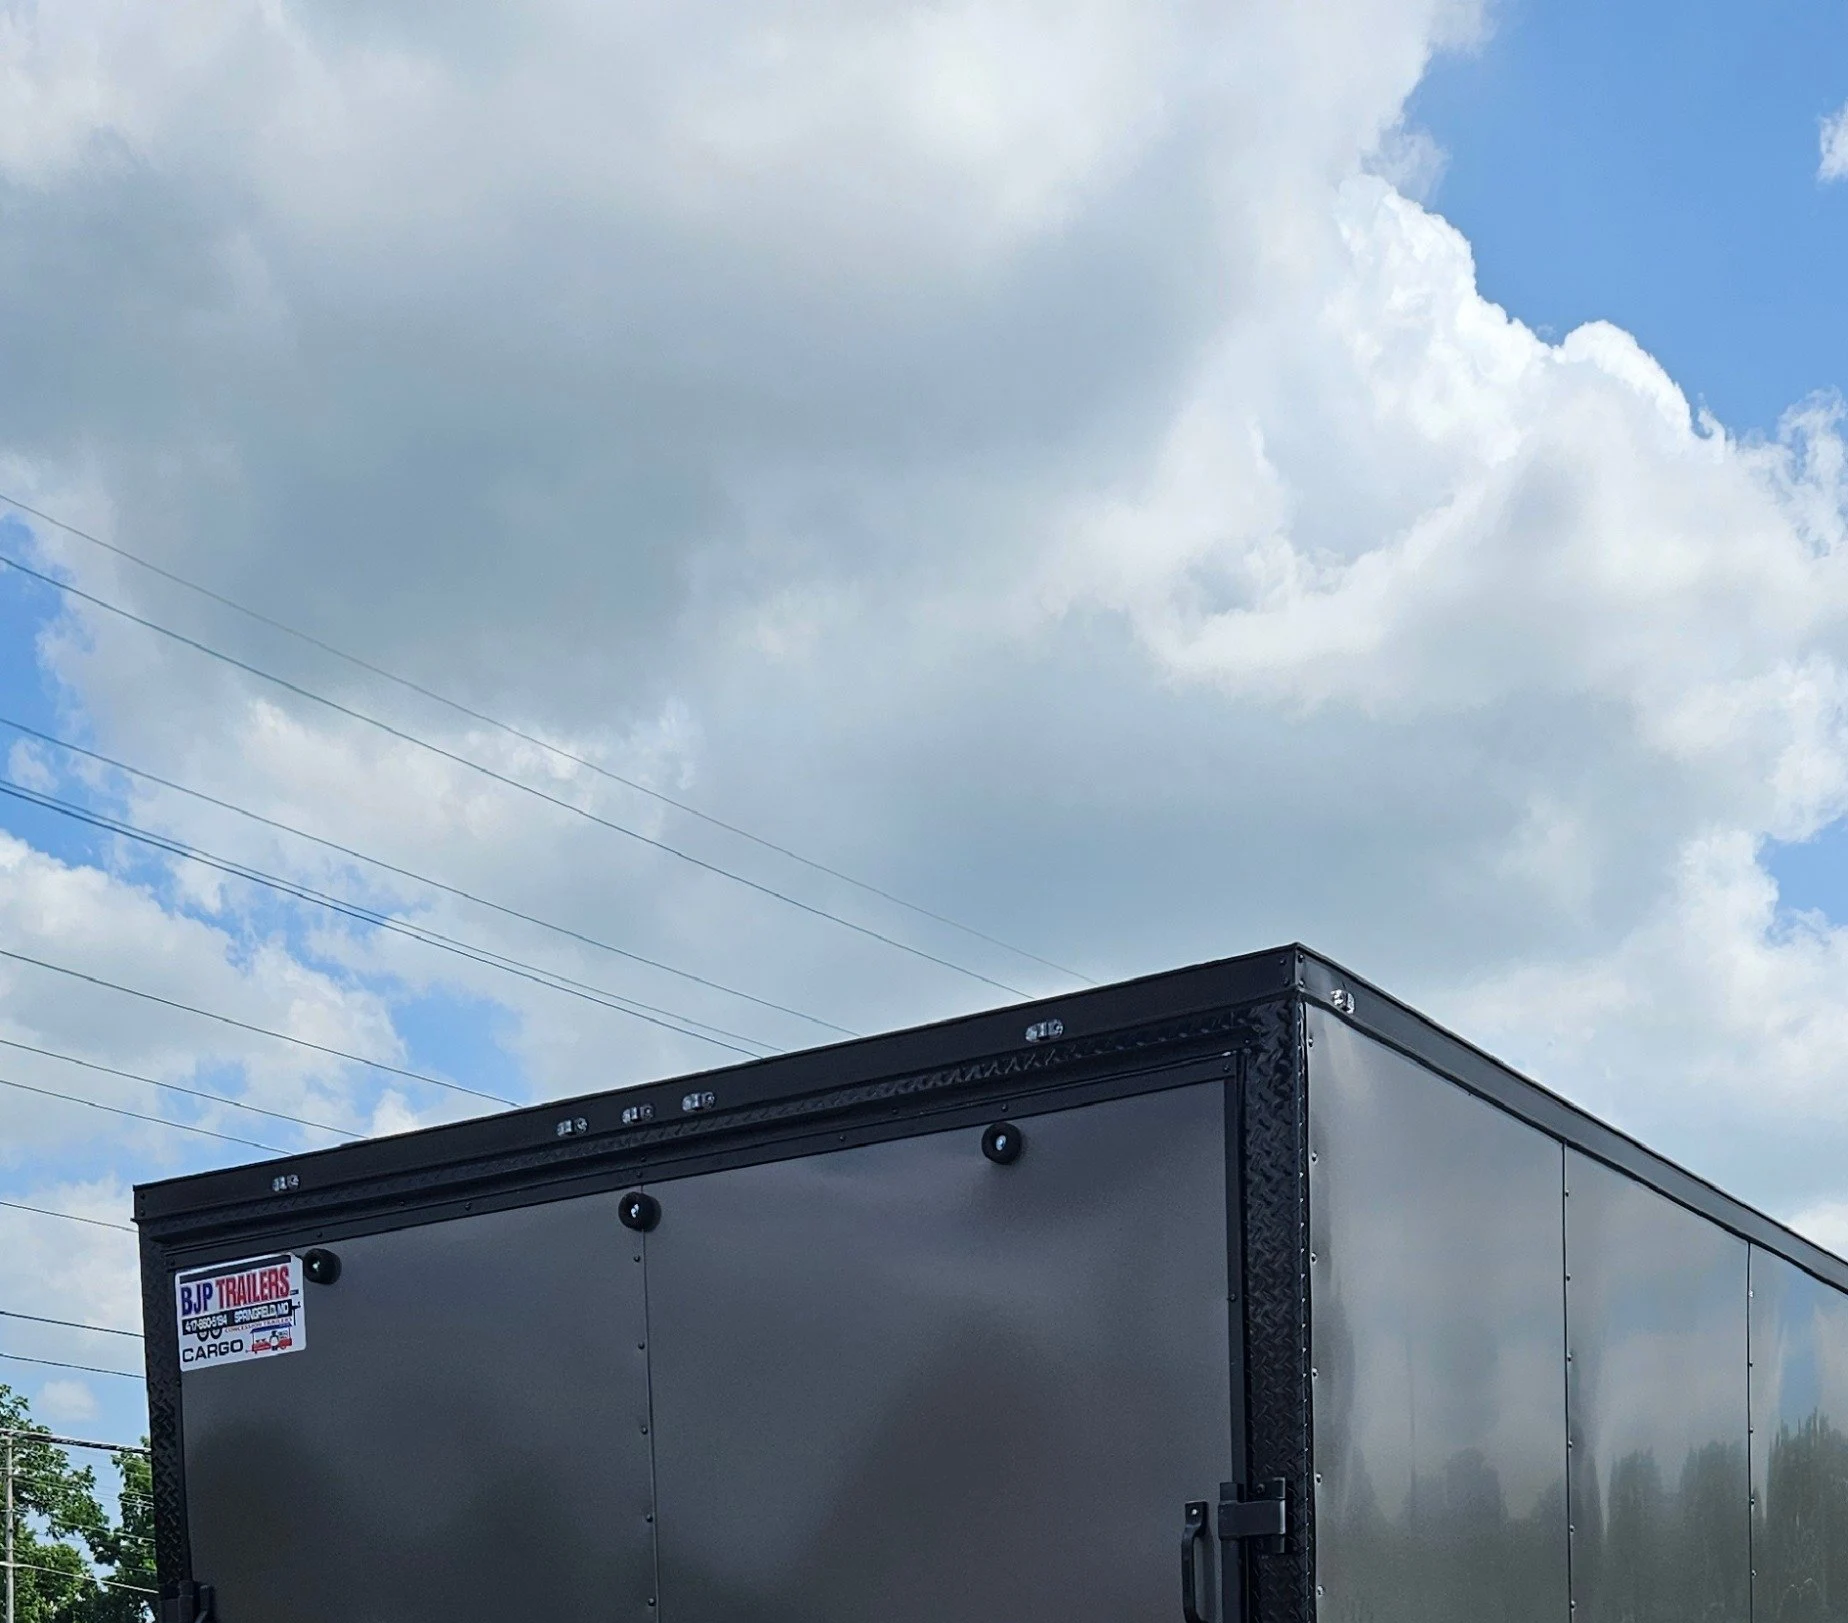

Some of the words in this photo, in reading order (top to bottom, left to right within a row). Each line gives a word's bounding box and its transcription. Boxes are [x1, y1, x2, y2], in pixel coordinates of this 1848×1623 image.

[181, 1283, 213, 1316] BJP
[216, 1266, 290, 1309] TRAILERS
[182, 1339, 244, 1363] CARGO
